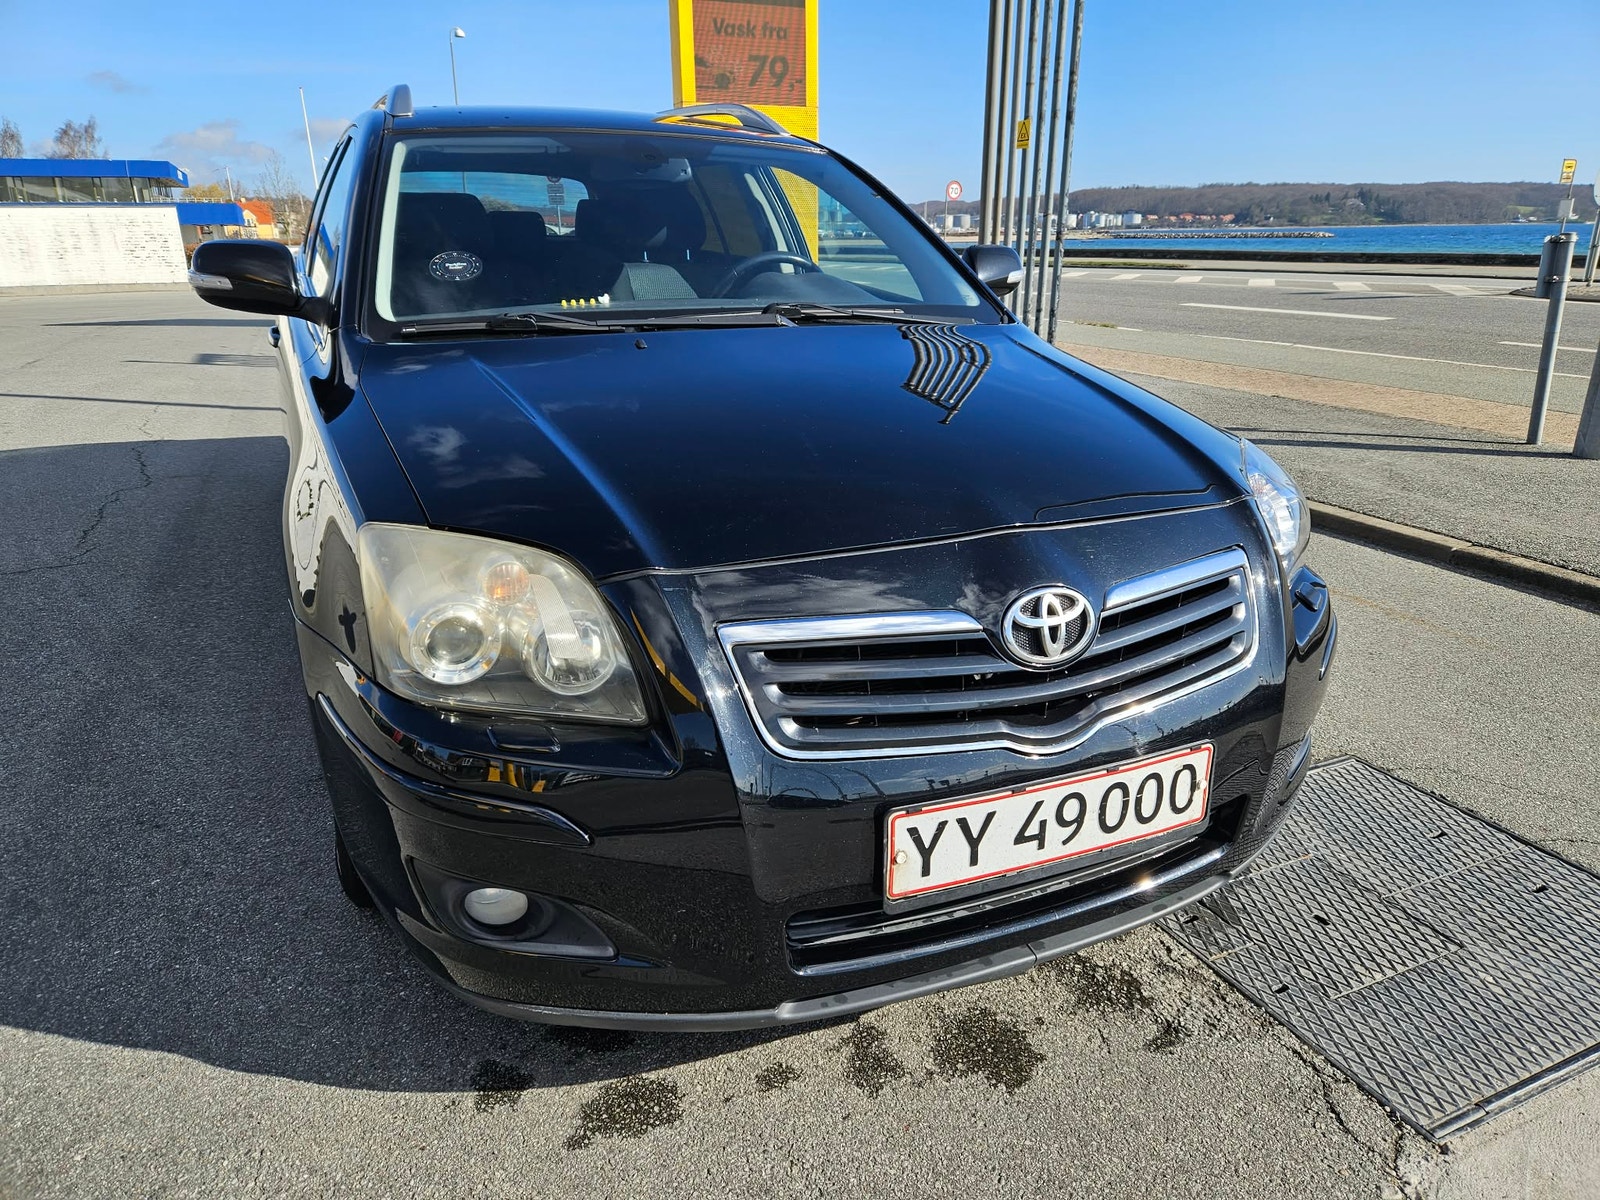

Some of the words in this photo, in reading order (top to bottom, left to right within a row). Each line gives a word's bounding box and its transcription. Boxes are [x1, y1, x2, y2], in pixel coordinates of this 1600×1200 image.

[712, 17, 757, 38] Vask
[761, 22, 789, 40] fra
[950, 187, 959, 195] 70
[906, 811, 997, 877] YY
